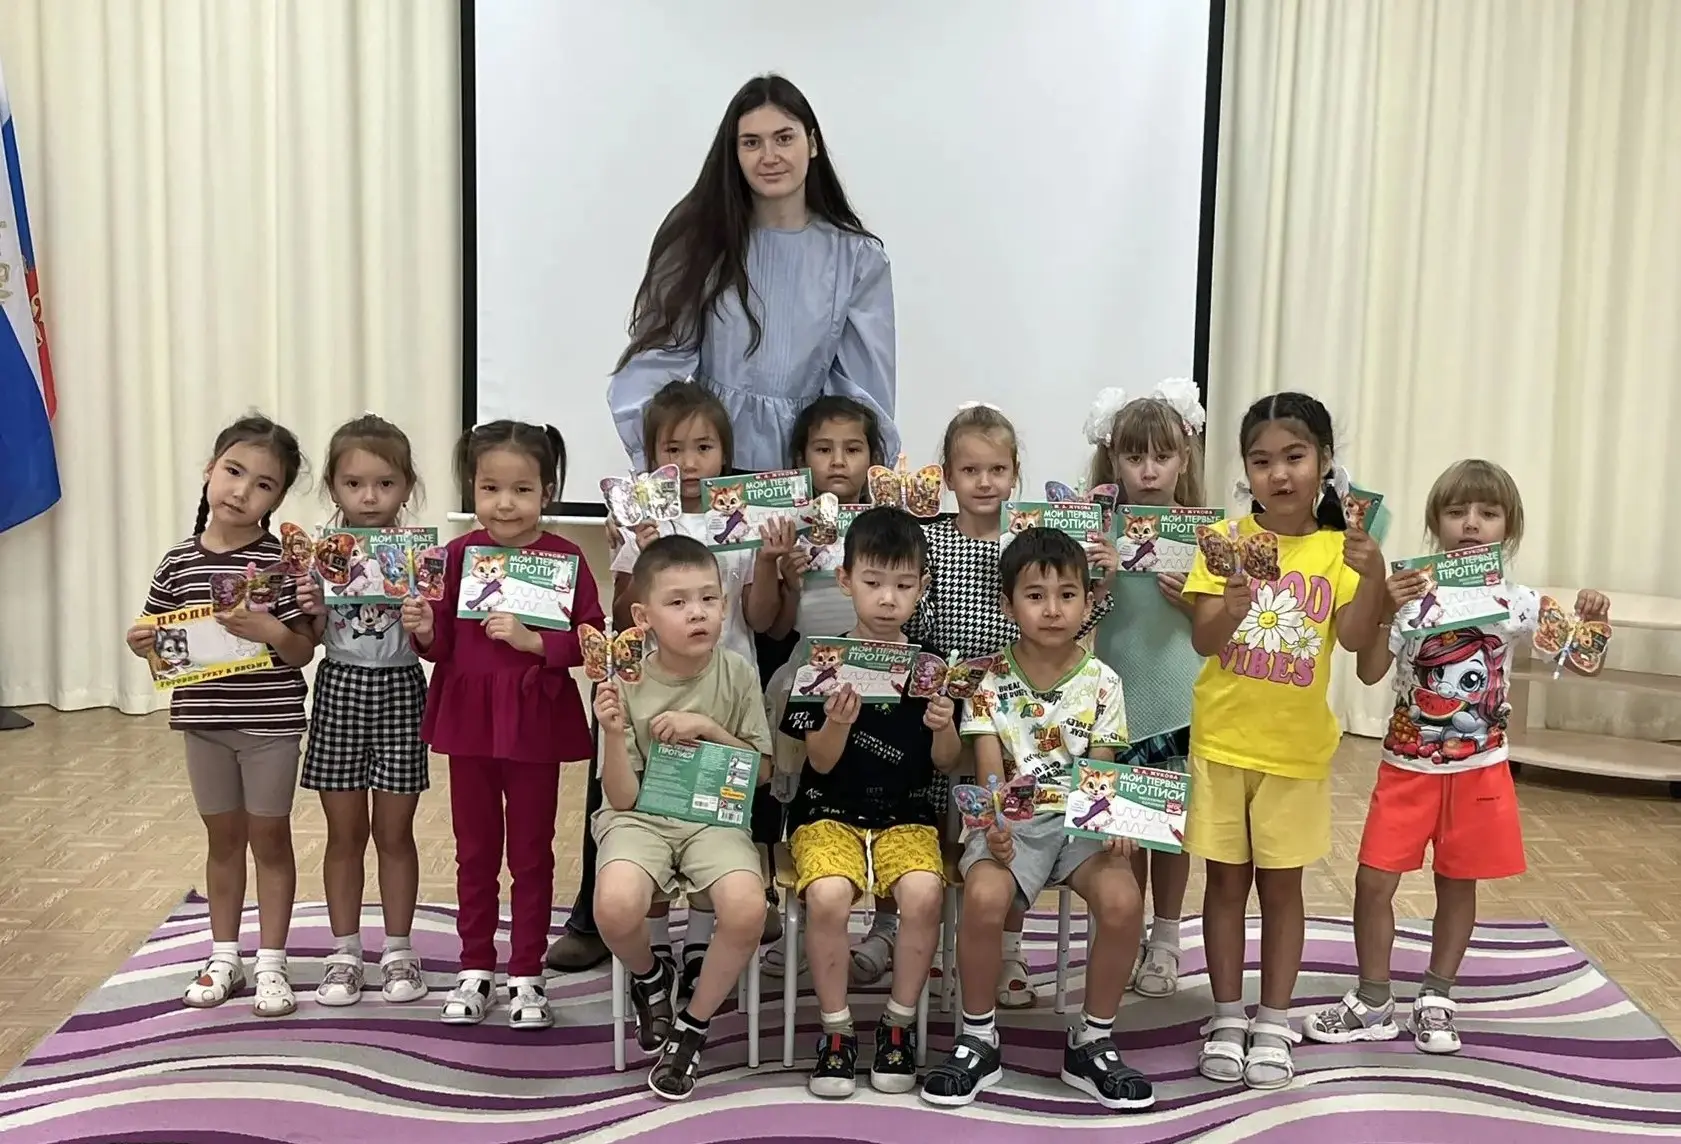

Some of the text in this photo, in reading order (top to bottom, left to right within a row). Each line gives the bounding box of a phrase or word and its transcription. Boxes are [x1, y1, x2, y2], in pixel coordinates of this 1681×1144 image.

[1043, 510, 1064, 518] МОИ
[1043, 518, 1099, 529] ПРОПИСИ
[1160, 523, 1197, 533] ПРОП
[509, 555, 532, 564] МОИ
[1436, 559, 1459, 570] МОИ
[1437, 561, 1500, 581] ПРОПИСИ
[156, 608, 211, 626] ПРОПИ
[849, 652, 912, 664] ПРОПИСИ
[1218, 643, 1316, 687] VIBES
[1119, 772, 1188, 791] МОИ ПЕРВЫЕ
[1119, 780, 1186, 802] ПРОПИСИ
